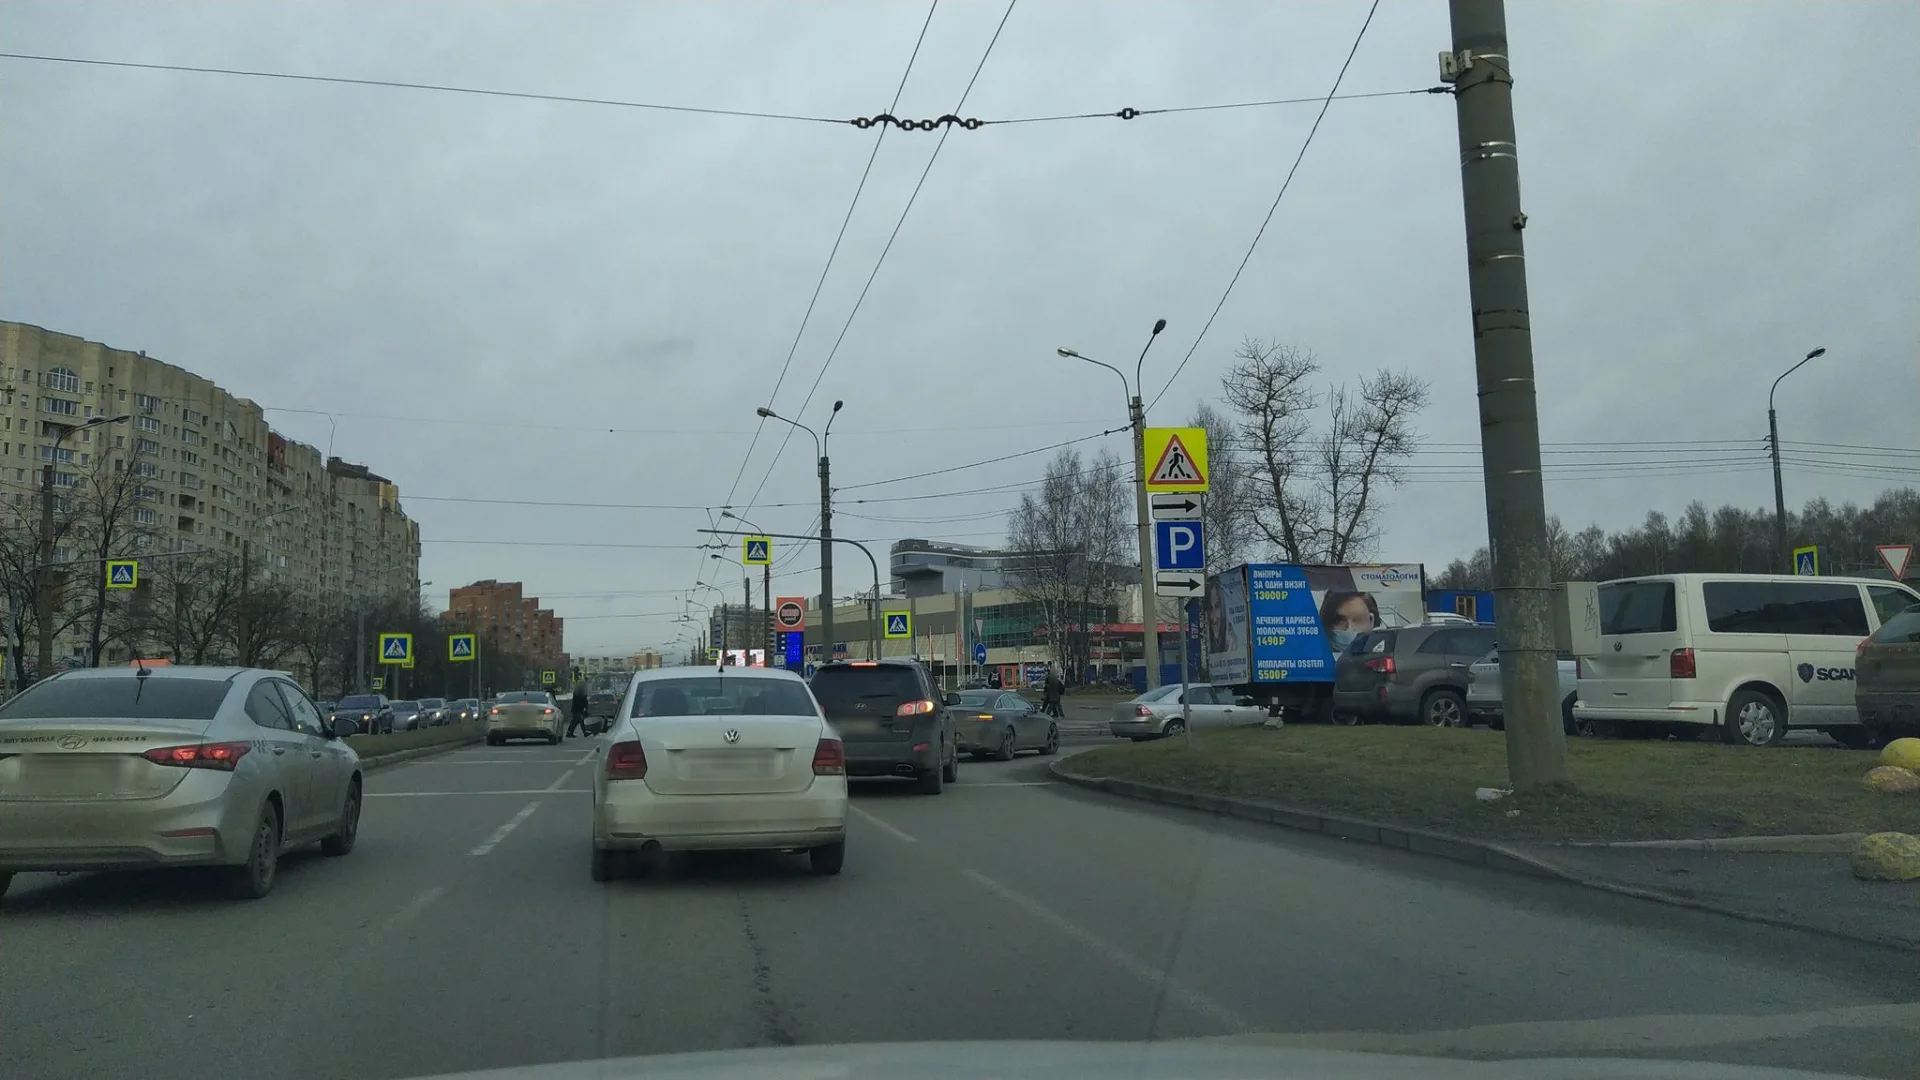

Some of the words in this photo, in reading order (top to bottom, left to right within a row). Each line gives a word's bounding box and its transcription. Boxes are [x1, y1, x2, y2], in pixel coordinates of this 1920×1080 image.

[1169, 526, 1195, 565] P
[1253, 570, 1282, 578] ВИНИРЫ
[1253, 580, 1264, 589] ЗА
[1264, 580, 1283, 589] ОДИН
[1284, 580, 1306, 589] ВИЗИТ
[1255, 616, 1284, 625] ЛЕЧЕНИЕ
[1285, 616, 1316, 625] КАРИЕСА
[1256, 626, 1296, 635] МОЛОЧНЫХ
[1296, 626, 1319, 635] ЗУБОВ
[1257, 659, 1297, 668] ИМПЛАНТЫ
